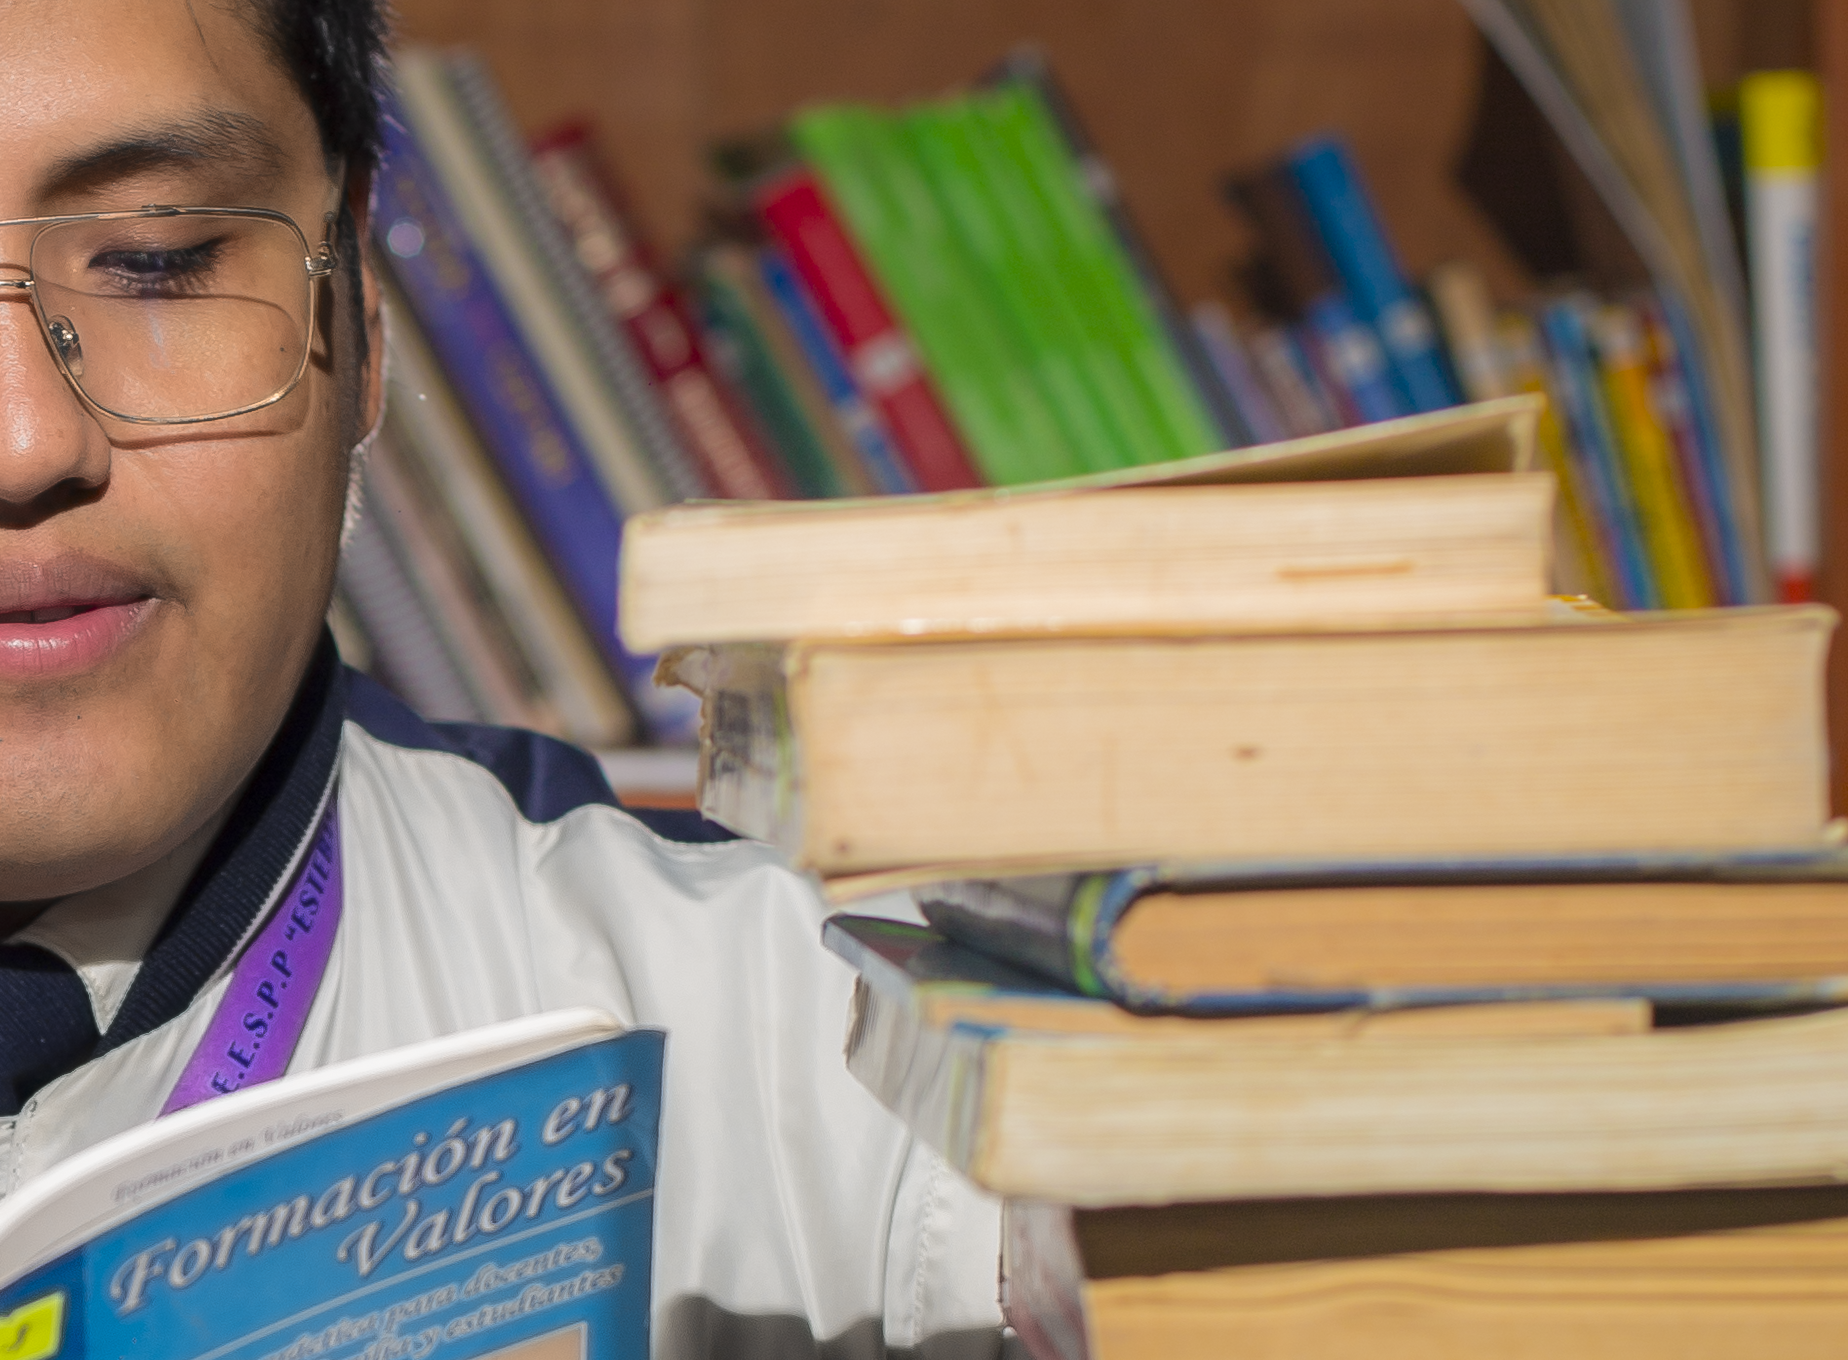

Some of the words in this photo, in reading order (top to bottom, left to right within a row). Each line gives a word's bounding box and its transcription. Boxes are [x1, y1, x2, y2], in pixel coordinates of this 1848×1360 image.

[108, 1118, 518, 1317] Formación
[542, 1082, 633, 1145] en
[336, 1147, 633, 1278] Valores
[378, 1283, 458, 1343] para
[443, 1262, 626, 1343] estudiantes
